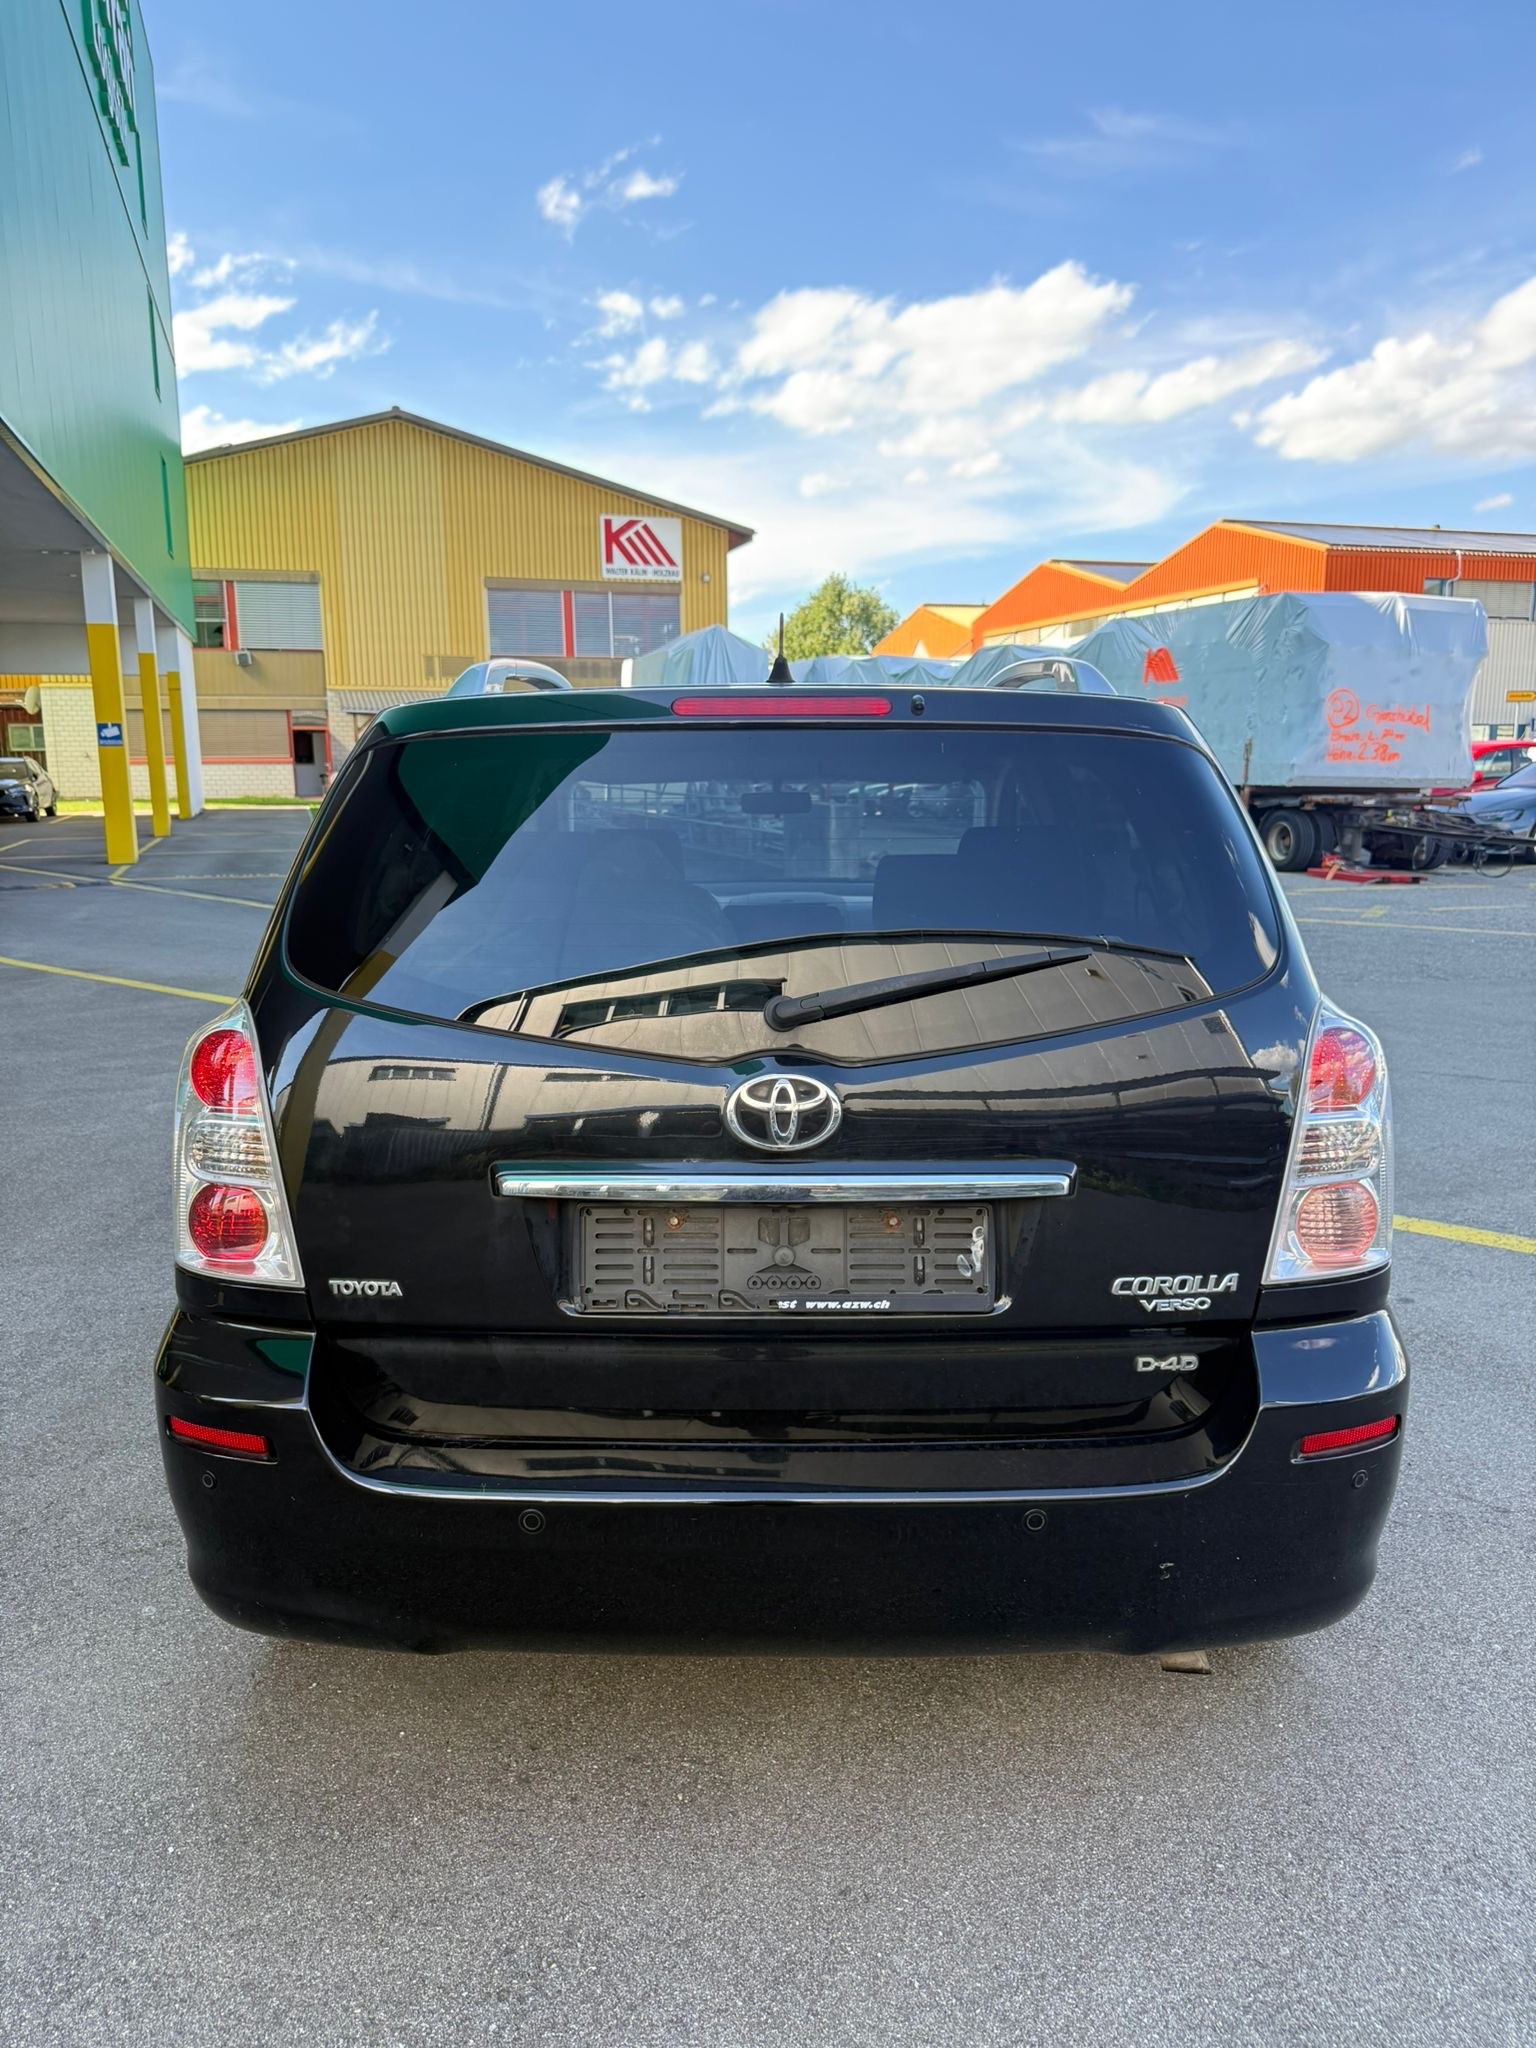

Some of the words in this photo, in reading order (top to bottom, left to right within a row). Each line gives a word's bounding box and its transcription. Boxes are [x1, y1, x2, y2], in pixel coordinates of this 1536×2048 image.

[327, 1279, 403, 1297] TOYOTA
[1111, 1273, 1240, 1295] COROLLA
[805, 1299, 891, 1309] www.azw.ch
[1139, 1297, 1212, 1312] VERSO
[1136, 1355, 1199, 1372] D-4D
